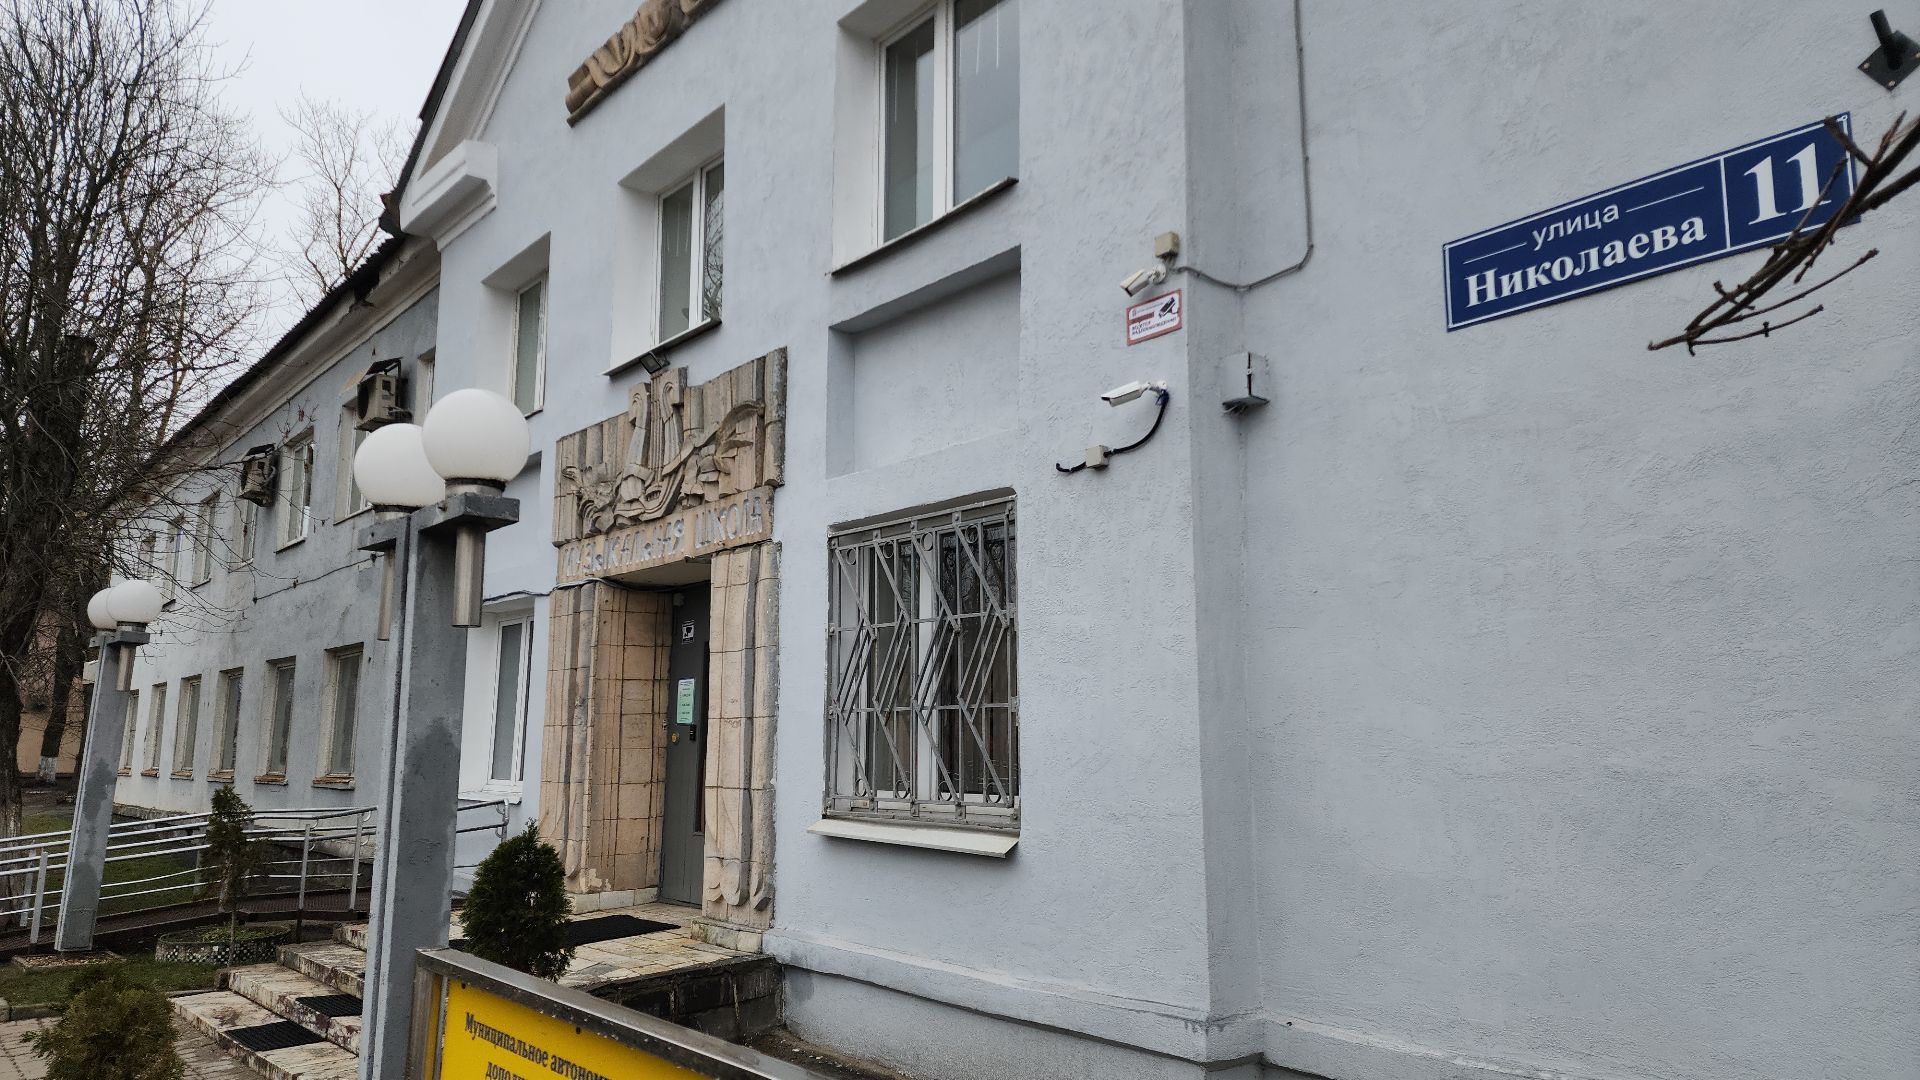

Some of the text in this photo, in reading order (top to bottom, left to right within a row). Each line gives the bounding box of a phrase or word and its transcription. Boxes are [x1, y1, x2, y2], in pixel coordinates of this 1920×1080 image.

[1743, 142, 1832, 225] 11
[1532, 204, 1619, 251] улица
[1465, 216, 1707, 308] Николаева
[694, 496, 763, 549] ШКОЛА
[465, 1012, 549, 1067] Муниципальное
